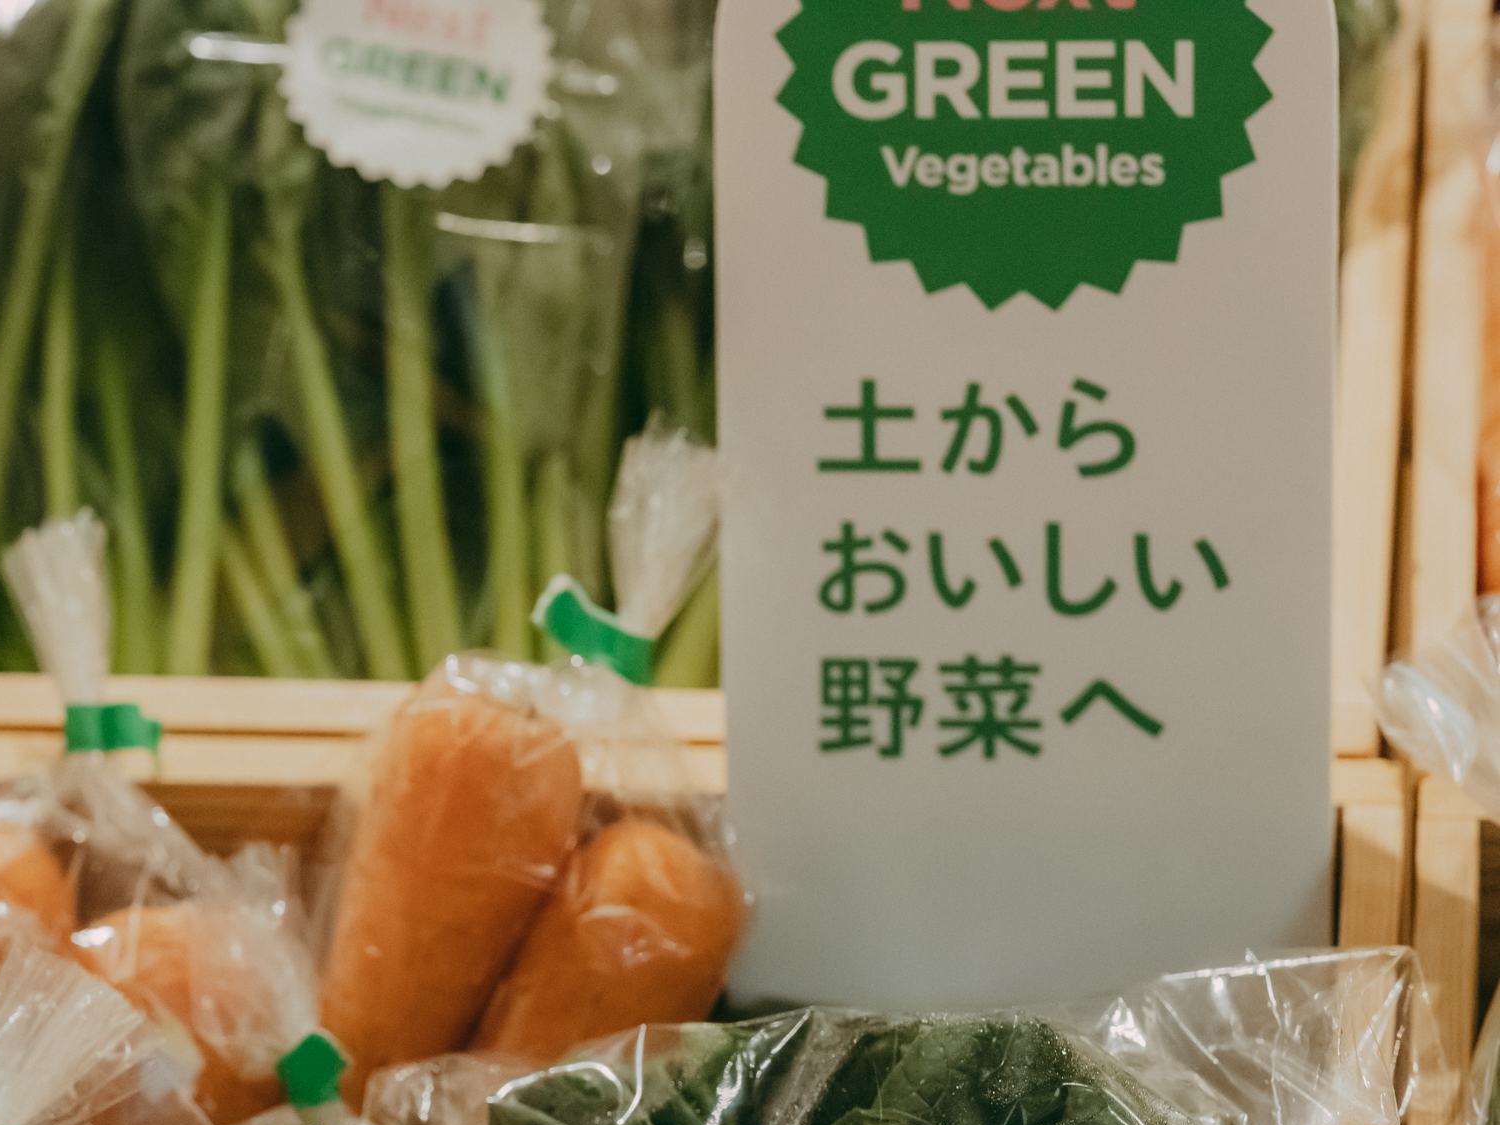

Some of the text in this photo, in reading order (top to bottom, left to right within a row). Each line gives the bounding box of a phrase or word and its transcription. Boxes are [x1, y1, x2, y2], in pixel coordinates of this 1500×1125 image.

[832, 39, 1195, 121] GREEN
[880, 143, 1166, 196] Vegetables
[817, 378, 1137, 479] 土から
[818, 521, 1230, 617] おいしい
[818, 655, 1164, 759] 野菜へ
